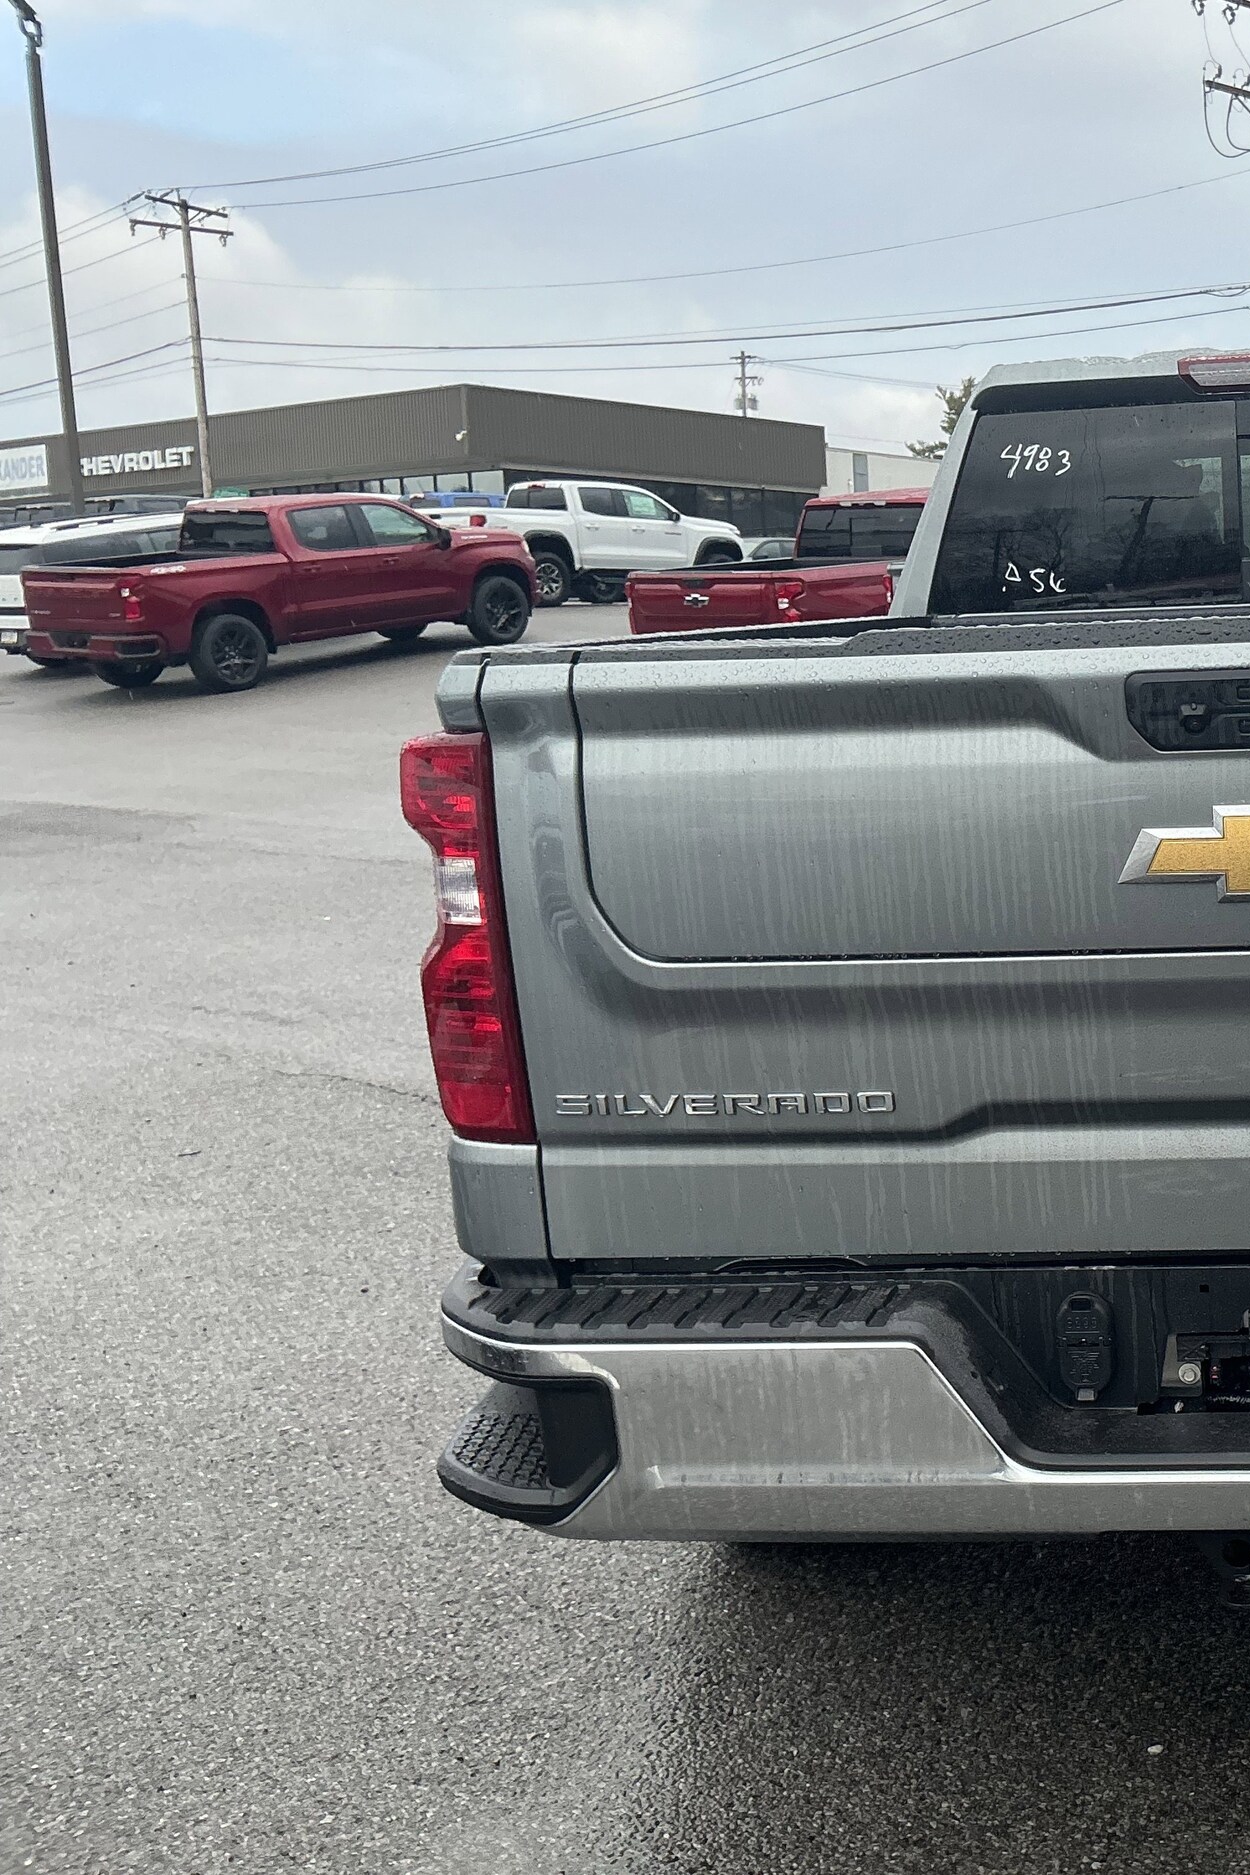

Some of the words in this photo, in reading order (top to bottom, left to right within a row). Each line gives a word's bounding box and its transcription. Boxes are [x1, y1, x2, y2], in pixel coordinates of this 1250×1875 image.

[0, 455, 45, 481] ANDER
[1000, 443, 1072, 479] 4983
[555, 1091, 896, 1117] SILVERADO
